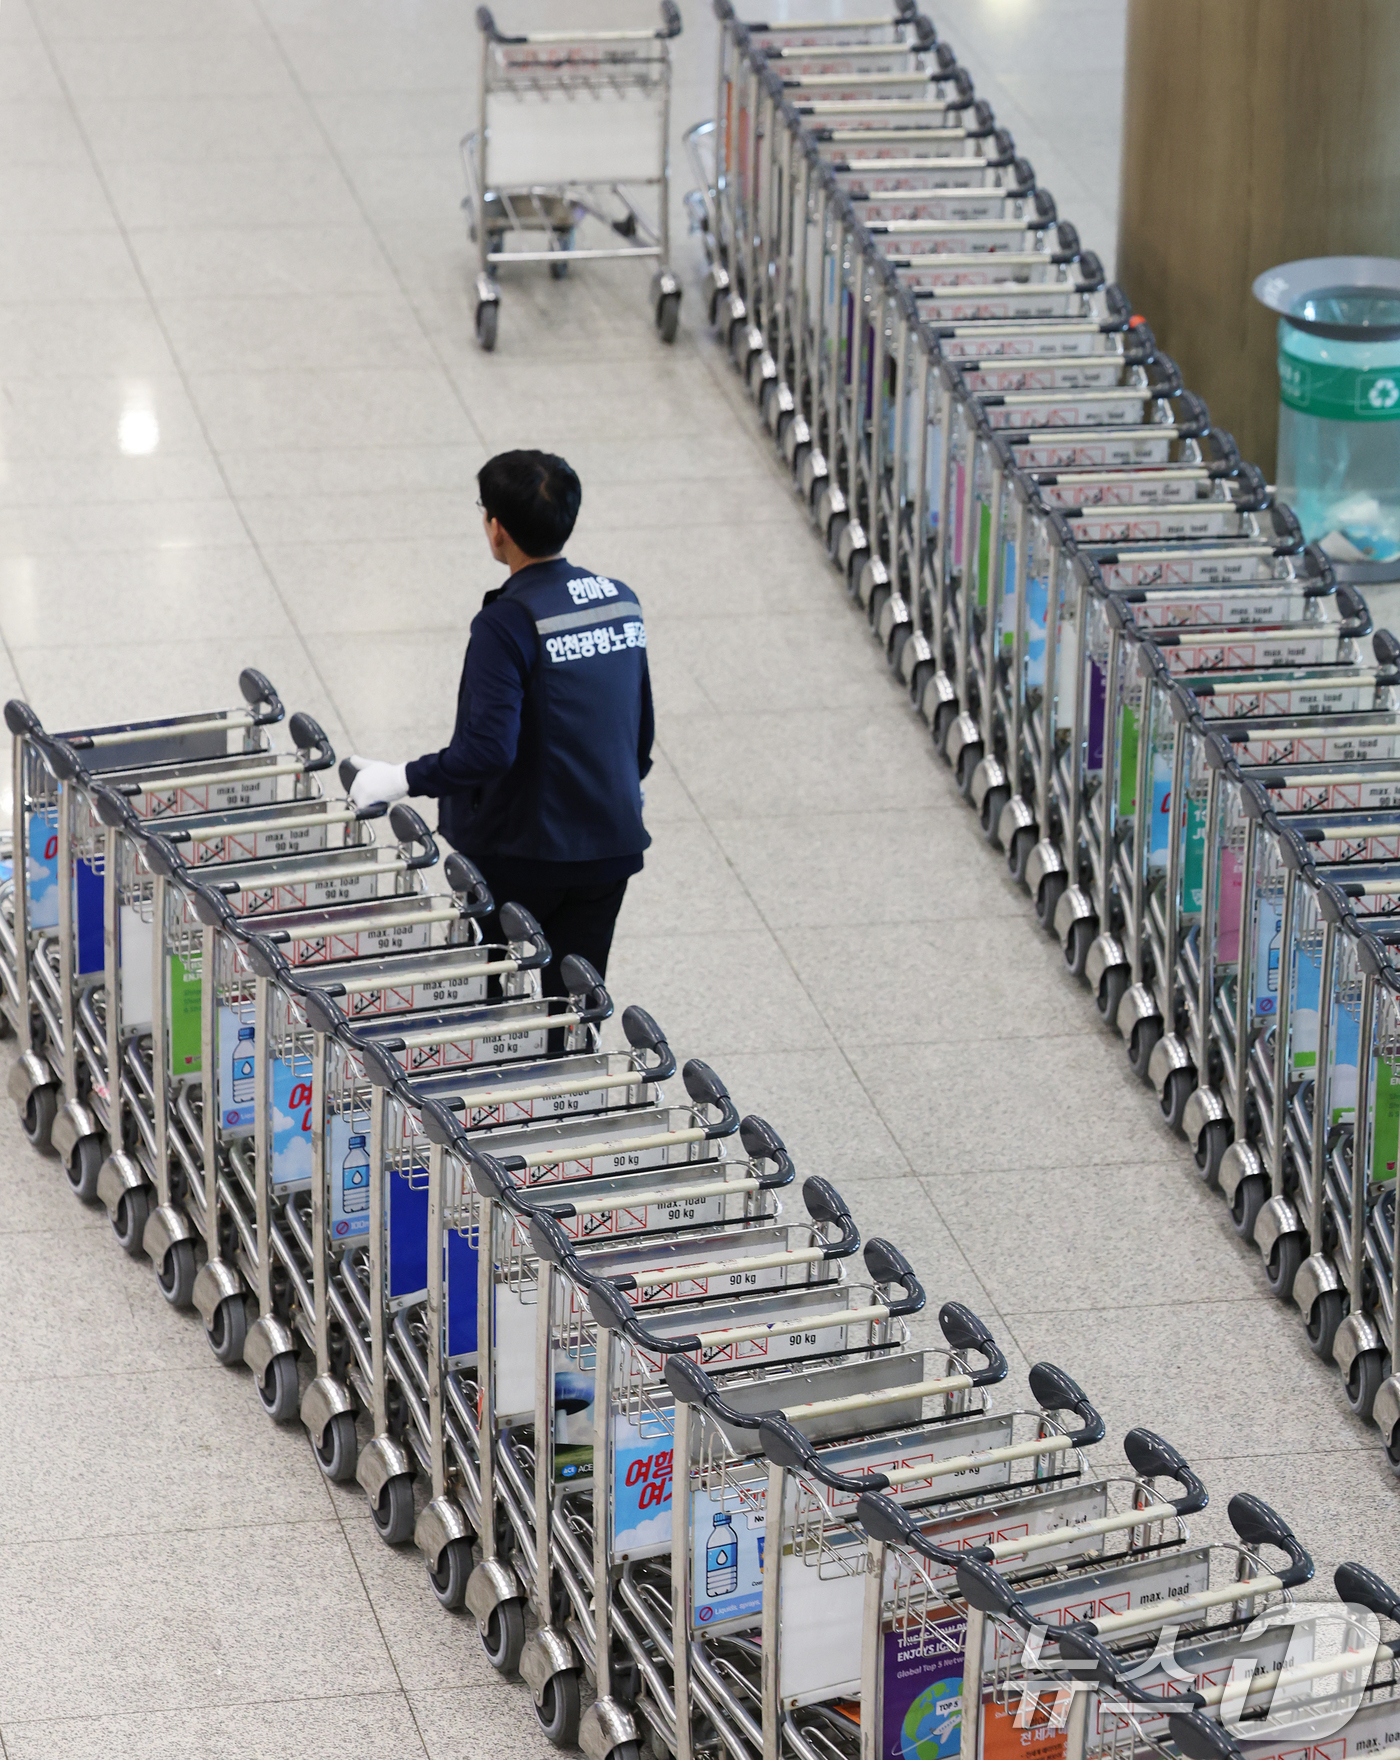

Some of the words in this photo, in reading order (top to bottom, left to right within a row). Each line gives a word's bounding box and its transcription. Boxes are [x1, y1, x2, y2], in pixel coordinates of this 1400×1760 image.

[566, 575, 619, 605] 한마음
[1358, 739, 1378, 748] load
[241, 782, 260, 792] load
[290, 829, 309, 838] load
[340, 877, 360, 886] load
[325, 890, 336, 899] 90
[339, 889, 350, 898] kg
[393, 925, 413, 935] load
[378, 939, 389, 949] 90
[392, 938, 403, 948] kg
[433, 989, 445, 1000] 90
[447, 989, 458, 1000] kg
[493, 1043, 505, 1054] 90
[507, 1042, 518, 1053] kg
[553, 1101, 565, 1111] 90
[568, 1100, 579, 1110] kg
[614, 1156, 625, 1167] 90
[628, 1155, 639, 1166] kg
[668, 1209, 680, 1220] 90
[683, 1208, 695, 1220] kg
[730, 1275, 741, 1285] 90
[745, 1273, 756, 1285] kg
[789, 1335, 801, 1346] 90
[805, 1333, 816, 1344] kg
[1140, 1591, 1164, 1605] max.
[1168, 1583, 1190, 1598] load
[896, 1665, 922, 1679] Global
[923, 1663, 937, 1672] Top
[1244, 1665, 1269, 1679] max.
[1272, 1656, 1295, 1672] load
[1356, 1737, 1381, 1751] max.
